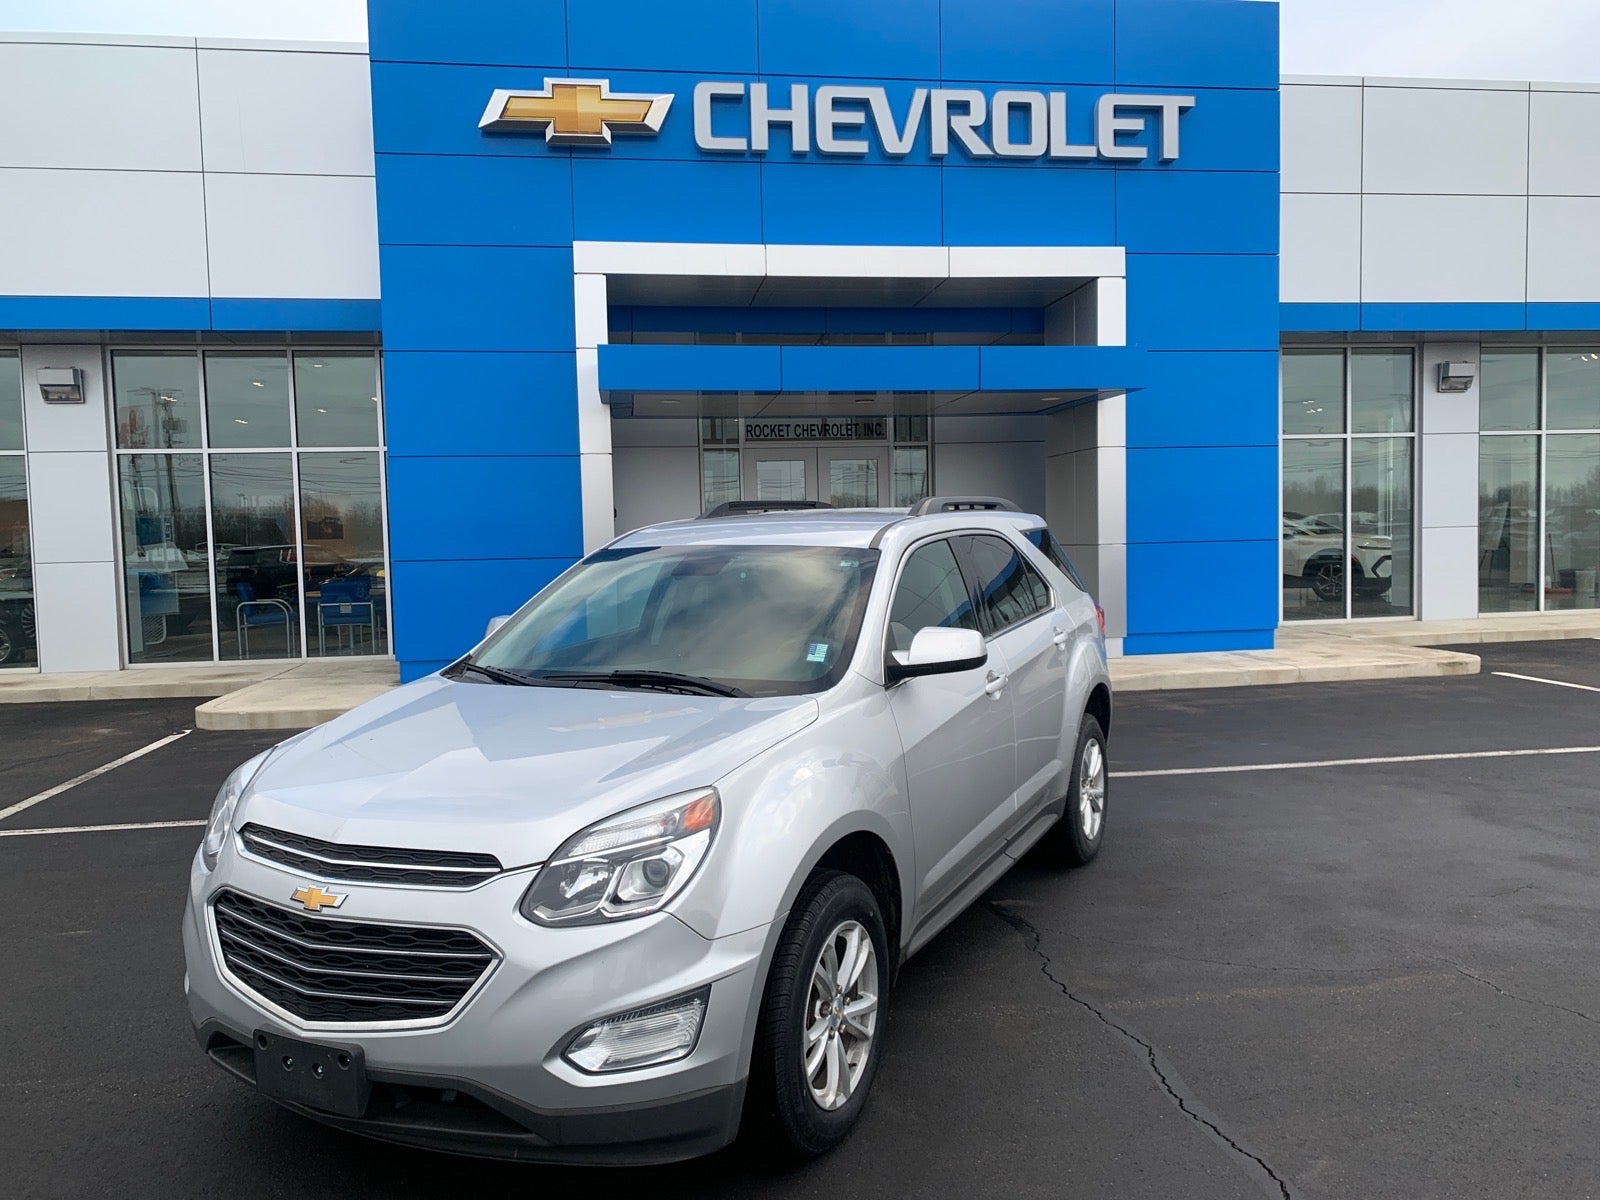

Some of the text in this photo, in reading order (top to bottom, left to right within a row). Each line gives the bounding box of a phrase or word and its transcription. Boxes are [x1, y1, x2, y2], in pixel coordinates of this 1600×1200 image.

[693, 81, 1196, 162] CHEVROLET
[746, 424, 791, 438] ROCKET
[863, 422, 885, 436] INC.
